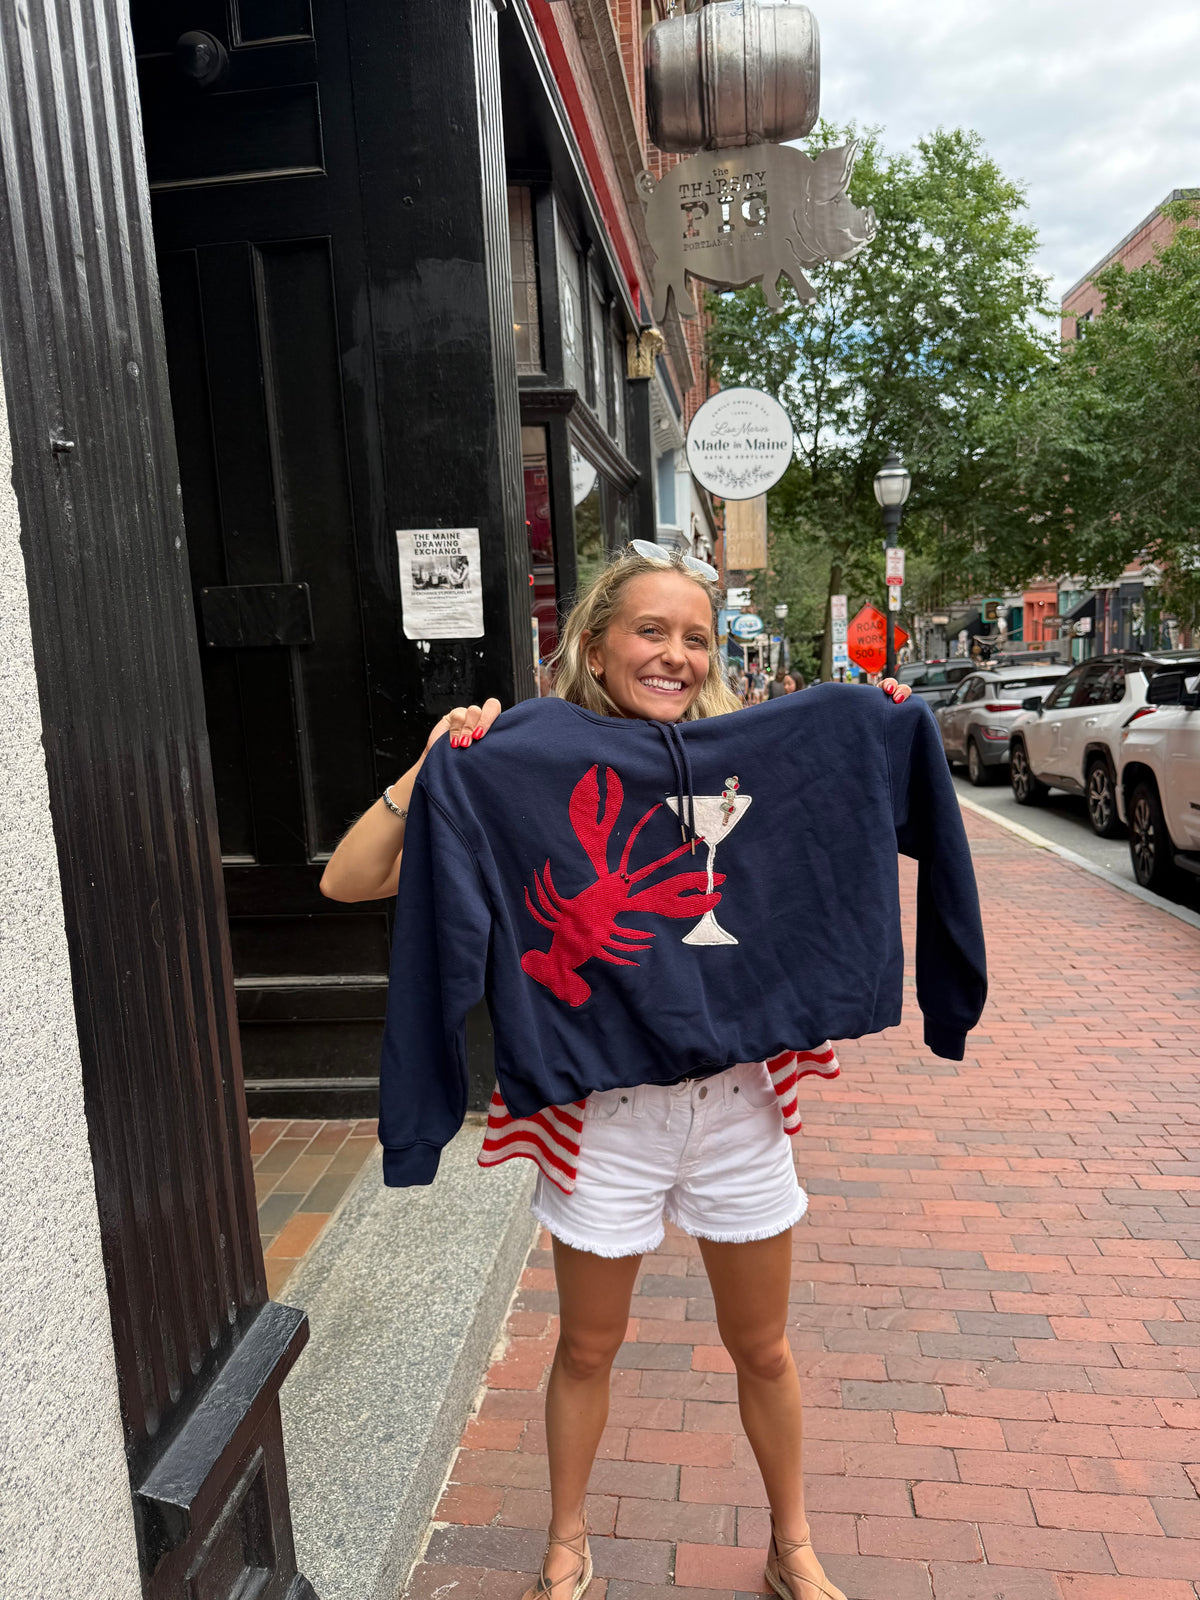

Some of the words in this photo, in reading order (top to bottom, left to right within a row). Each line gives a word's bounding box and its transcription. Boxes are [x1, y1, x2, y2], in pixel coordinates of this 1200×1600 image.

[712, 168, 729, 176] the
[680, 190, 770, 239] PIG
[693, 439, 730, 451] Made
[733, 440, 742, 449] in
[745, 438, 788, 451] Maine
[413, 533, 430, 541] THE
[432, 532, 461, 540] MAINE
[415, 540, 459, 548] DRAWING
[414, 547, 463, 556] EXCHANGE
[856, 620, 884, 633] ROAD
[857, 634, 886, 645] WORK
[855, 648, 874, 659] 500
